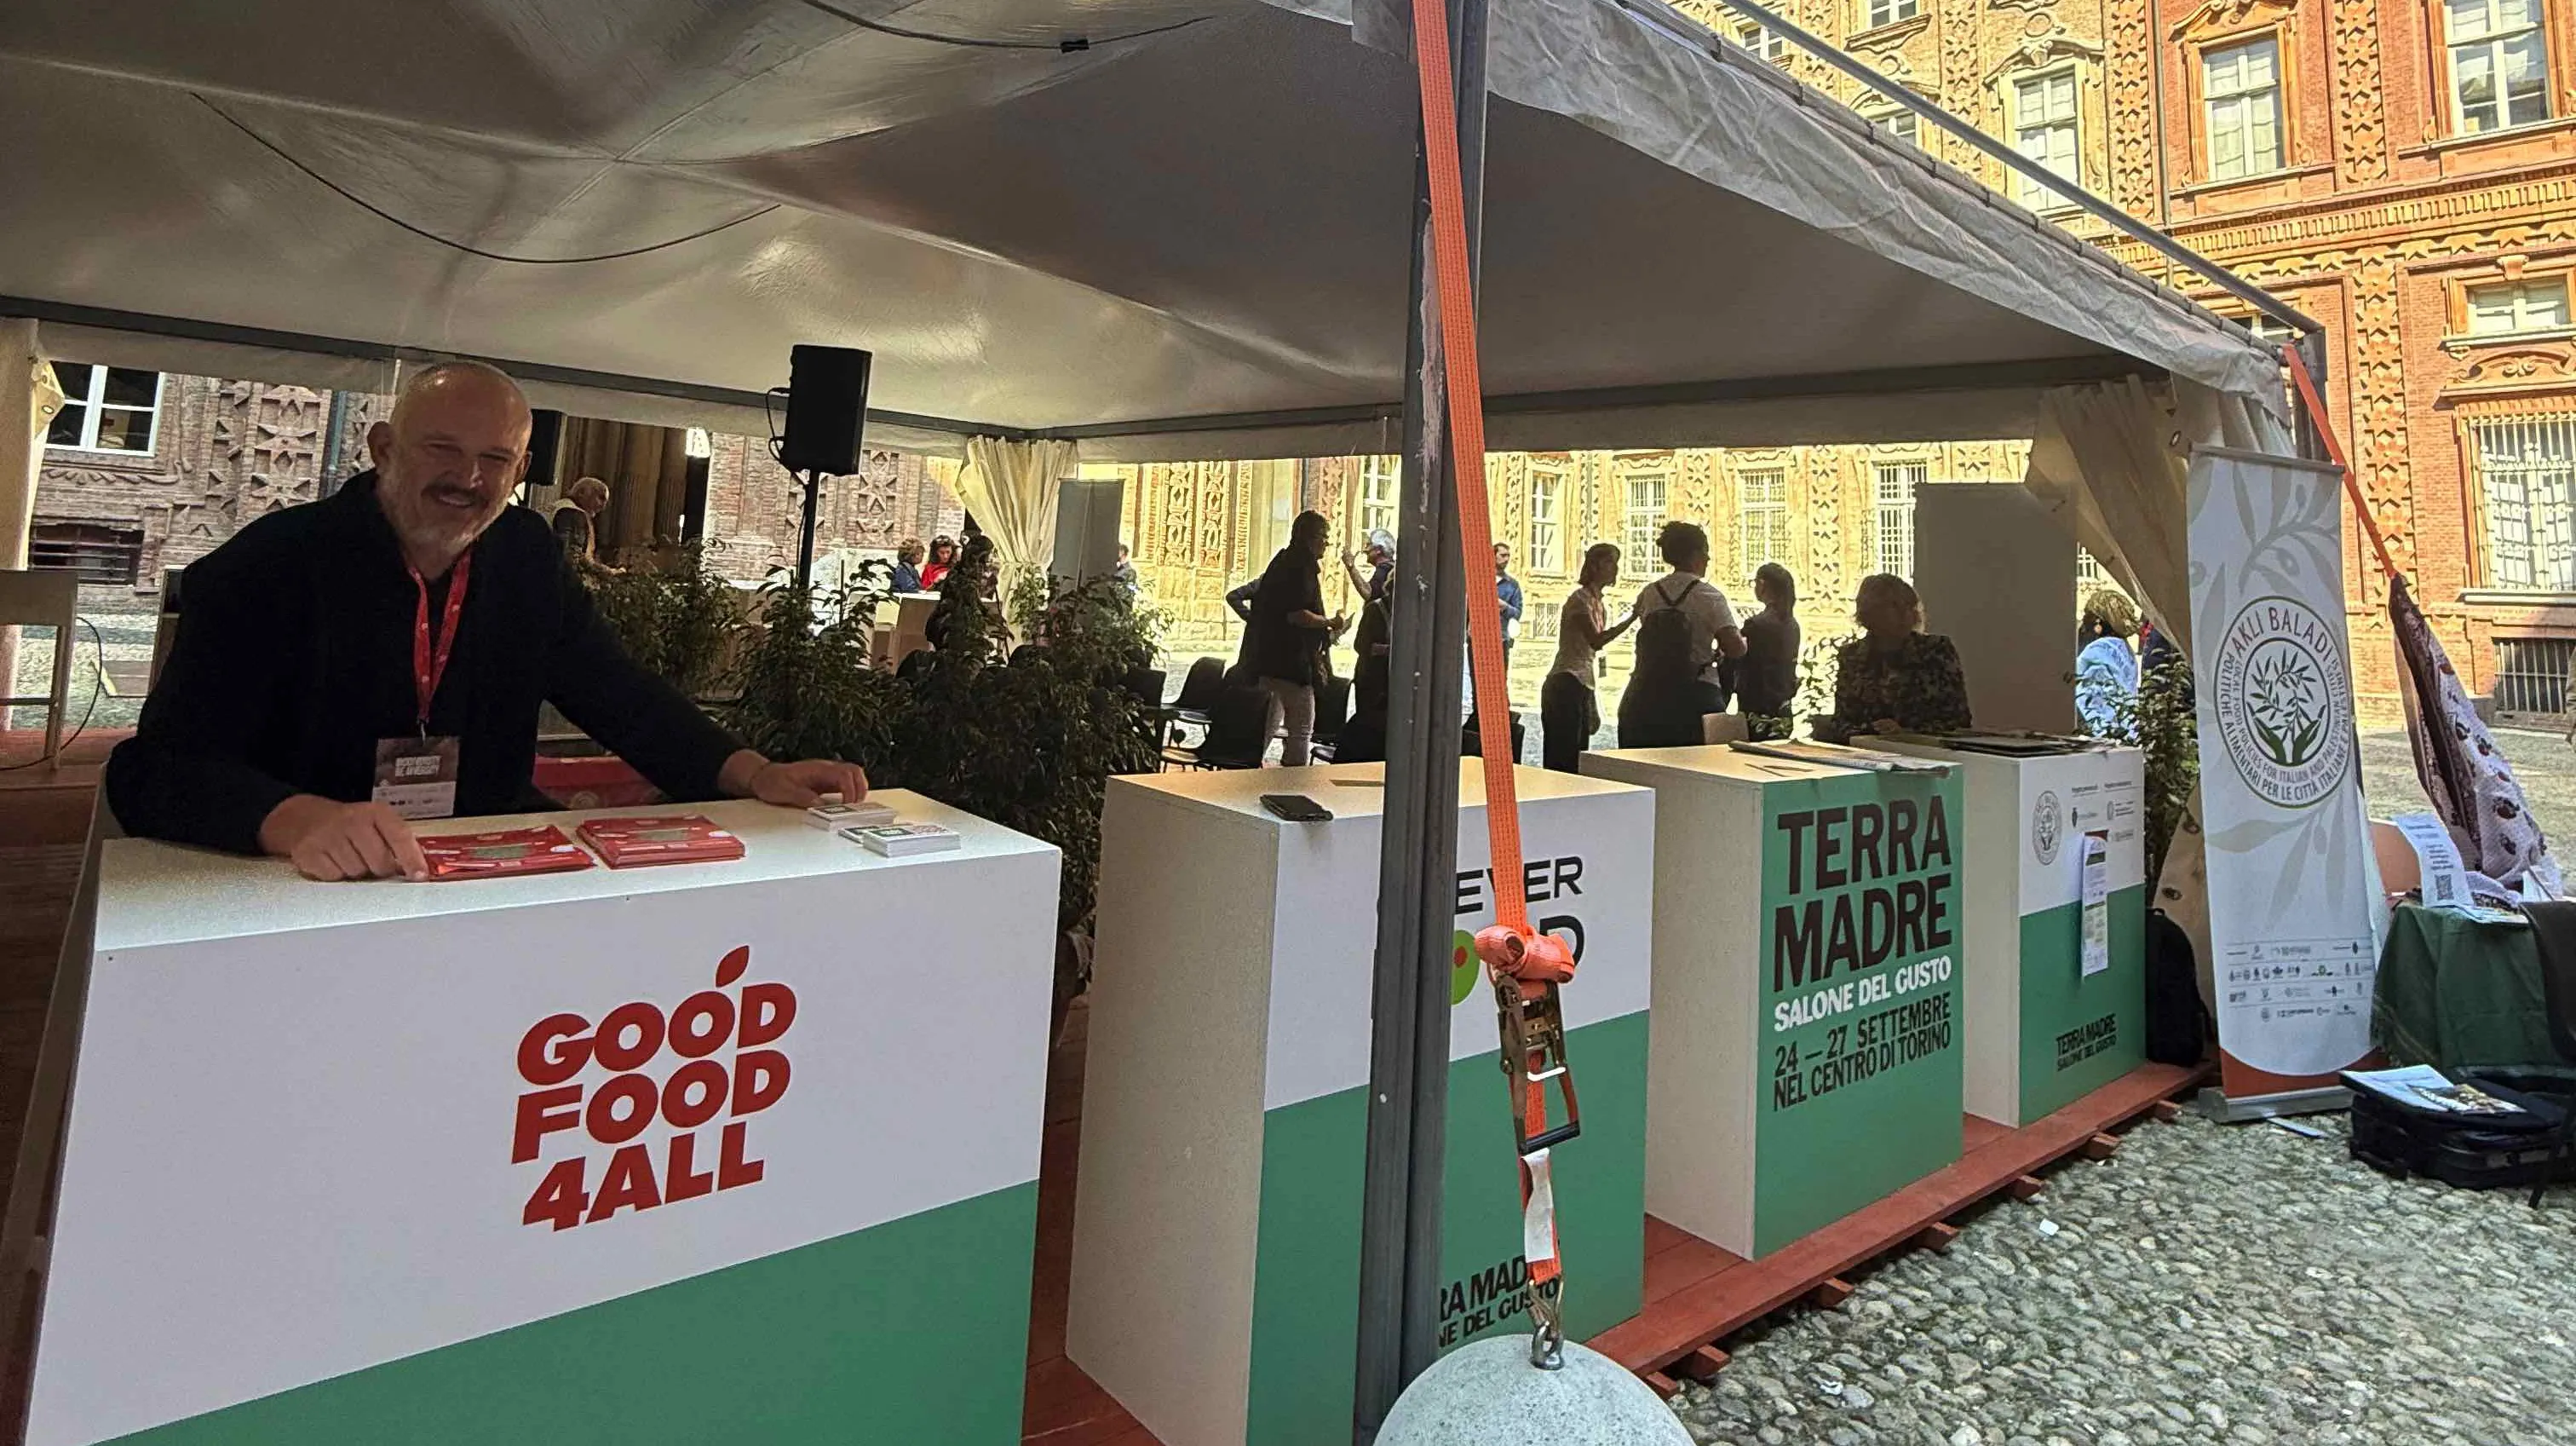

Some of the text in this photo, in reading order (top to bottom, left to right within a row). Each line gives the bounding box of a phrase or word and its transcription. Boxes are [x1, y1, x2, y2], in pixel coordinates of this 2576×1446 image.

[2232, 606, 2334, 662] AKLI BALADI
[2220, 651, 2235, 718] POLITICHE
[2224, 722, 2262, 786] ALIMENTARI
[2263, 763, 2278, 780] FOR
[2262, 779, 2279, 798] PER
[2280, 786, 2292, 801] LE
[1777, 795, 1952, 896] TERRA
[1456, 856, 1584, 915] EER
[1774, 873, 1952, 993] MADRE
[1774, 955, 1952, 1032] SALONE DEL GUSTO
[517, 982, 797, 1086] GOOD
[1774, 1040, 1799, 1078] 24
[1826, 1023, 1849, 1062] 27
[1857, 992, 1952, 1050] SETTEMBRE
[2056, 1012, 2117, 1057] TERRA MADRE
[1774, 1021, 1952, 1113] NEL CENTRO DI TORINO
[511, 1049, 791, 1165] FOOD
[522, 1121, 765, 1232] 4ALL
[1470, 1254, 1527, 1309] MAD
[1463, 1306, 1496, 1338] DEL
